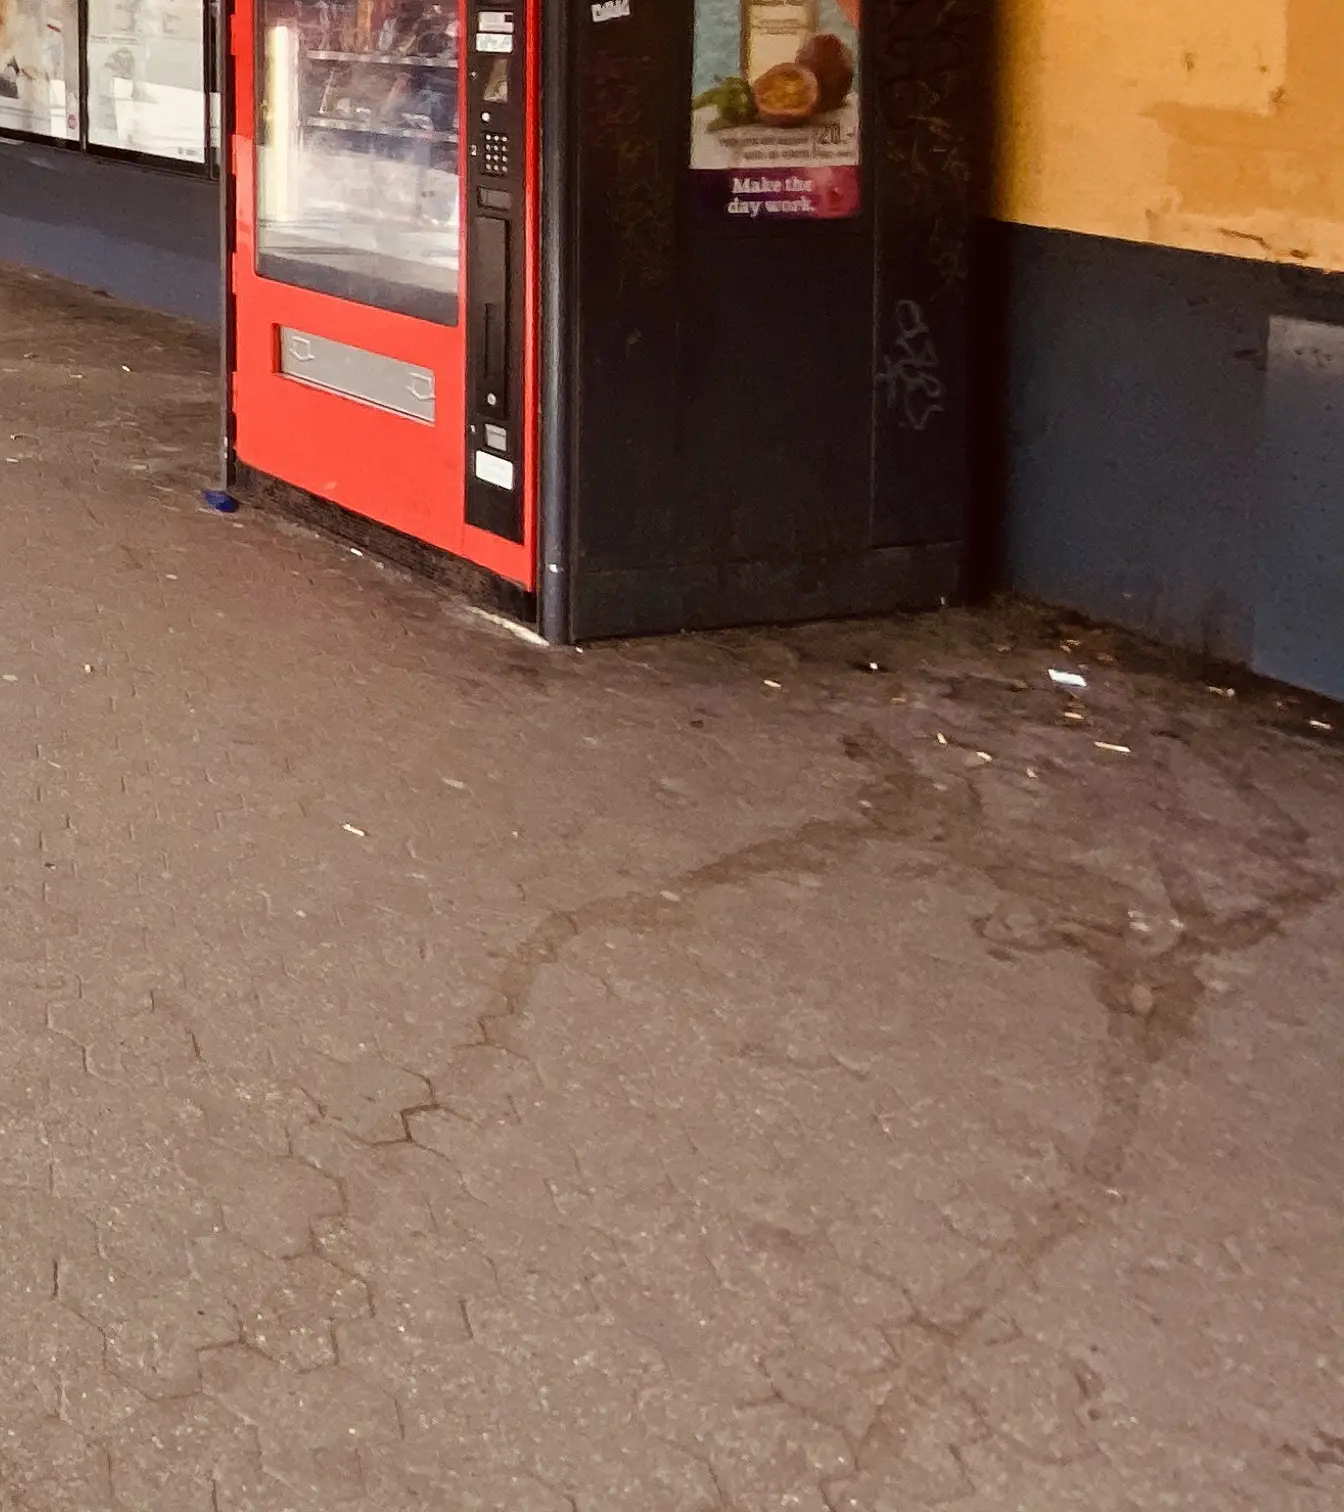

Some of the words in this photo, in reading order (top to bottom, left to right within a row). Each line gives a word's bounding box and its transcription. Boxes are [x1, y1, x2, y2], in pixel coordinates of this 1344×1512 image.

[732, 177, 782, 194] Make
[785, 175, 813, 192] the
[727, 196, 763, 218] day
